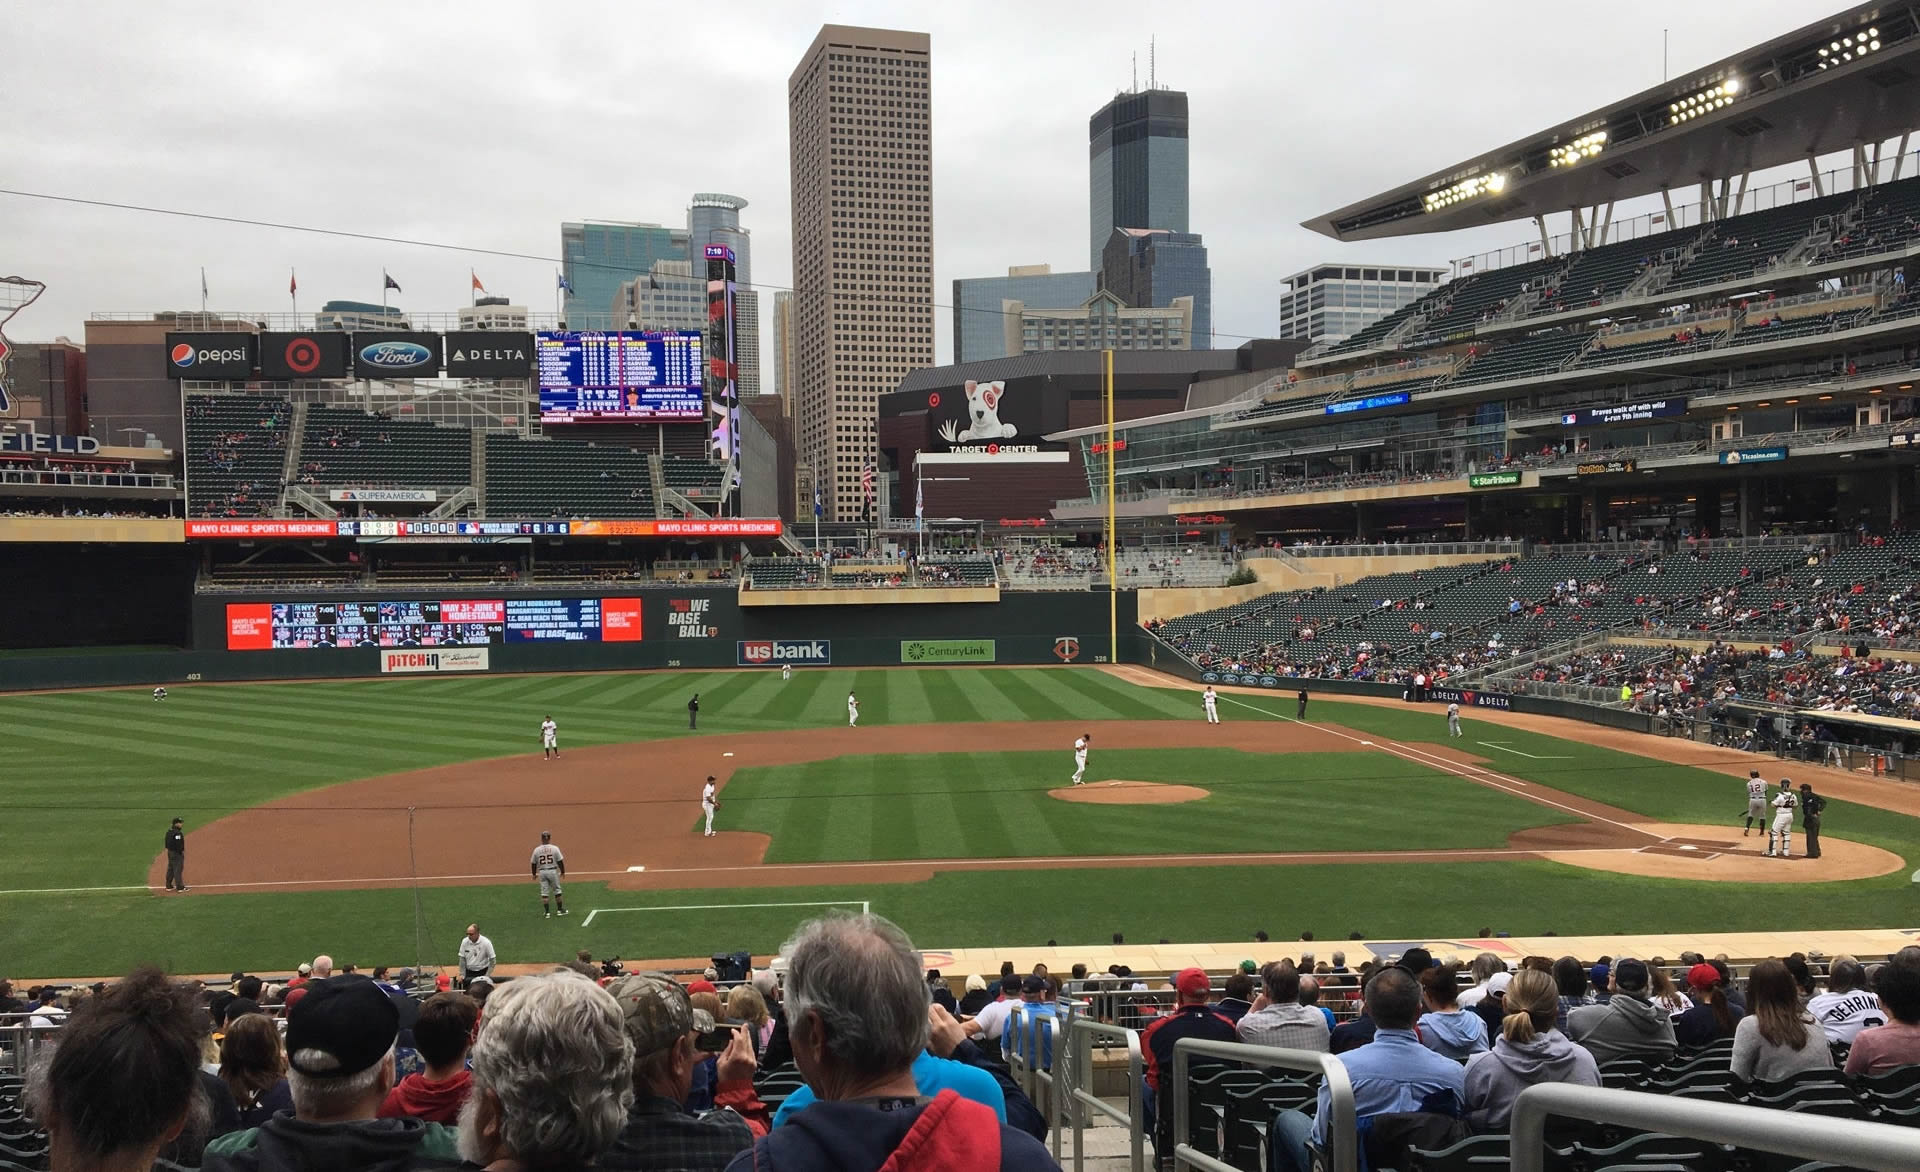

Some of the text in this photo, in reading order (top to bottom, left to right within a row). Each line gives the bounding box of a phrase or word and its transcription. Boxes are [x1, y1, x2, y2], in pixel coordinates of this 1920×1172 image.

[198, 347, 246, 364] pepsi
[373, 345, 418, 364] Ford
[471, 349, 525, 360] DELTA
[1652, 401, 1666, 409] wild
[1633, 411, 1652, 419] inning
[0, 432, 100, 454] FIELD
[999, 445, 1037, 453] CENTER
[1480, 476, 1516, 485] StarTribune
[359, 492, 426, 500] SUPERAMERICA
[192, 524, 330, 533] MAYO CLINIC SPORTS MEDICINE
[533, 524, 540, 533] 6
[560, 524, 567, 534] 6
[658, 524, 776, 532] MAYO CLINIC SPORTS MEDICINE
[442, 604, 458, 612] MAY
[691, 600, 710, 611] WE
[449, 612, 497, 620] HOMESTAND
[669, 612, 700, 625] BASE
[273, 618, 293, 626] A.L.
[534, 630, 546, 638] WE
[547, 630, 567, 638] BASE
[565, 632, 584, 640] BALL
[679, 625, 708, 638] BALL
[273, 640, 293, 648] N.L.
[928, 647, 985, 657] CenturyLink
[1438, 692, 1459, 701] DELTA
[1486, 698, 1509, 706] DELTA
[1750, 784, 1761, 792] 12
[539, 854, 553, 865] 25
